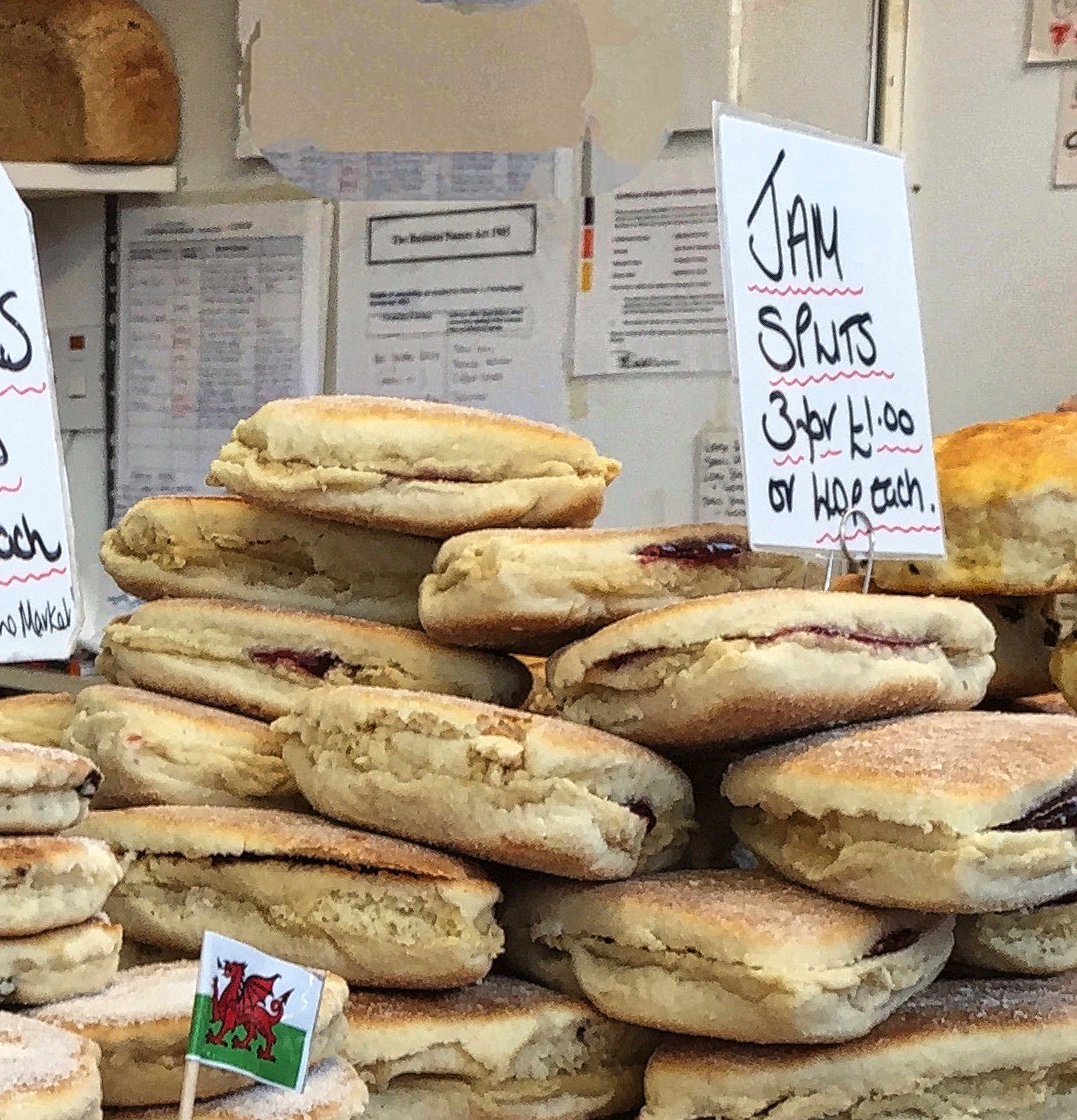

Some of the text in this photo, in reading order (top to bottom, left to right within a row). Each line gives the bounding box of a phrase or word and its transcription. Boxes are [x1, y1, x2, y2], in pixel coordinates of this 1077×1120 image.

[748, 149, 843, 282] JAM
[759, 302, 878, 372] SPLITS
[762, 390, 915, 465] 3 for £1.00
[768, 473, 795, 513] or
[812, 472, 863, 526] 40p
